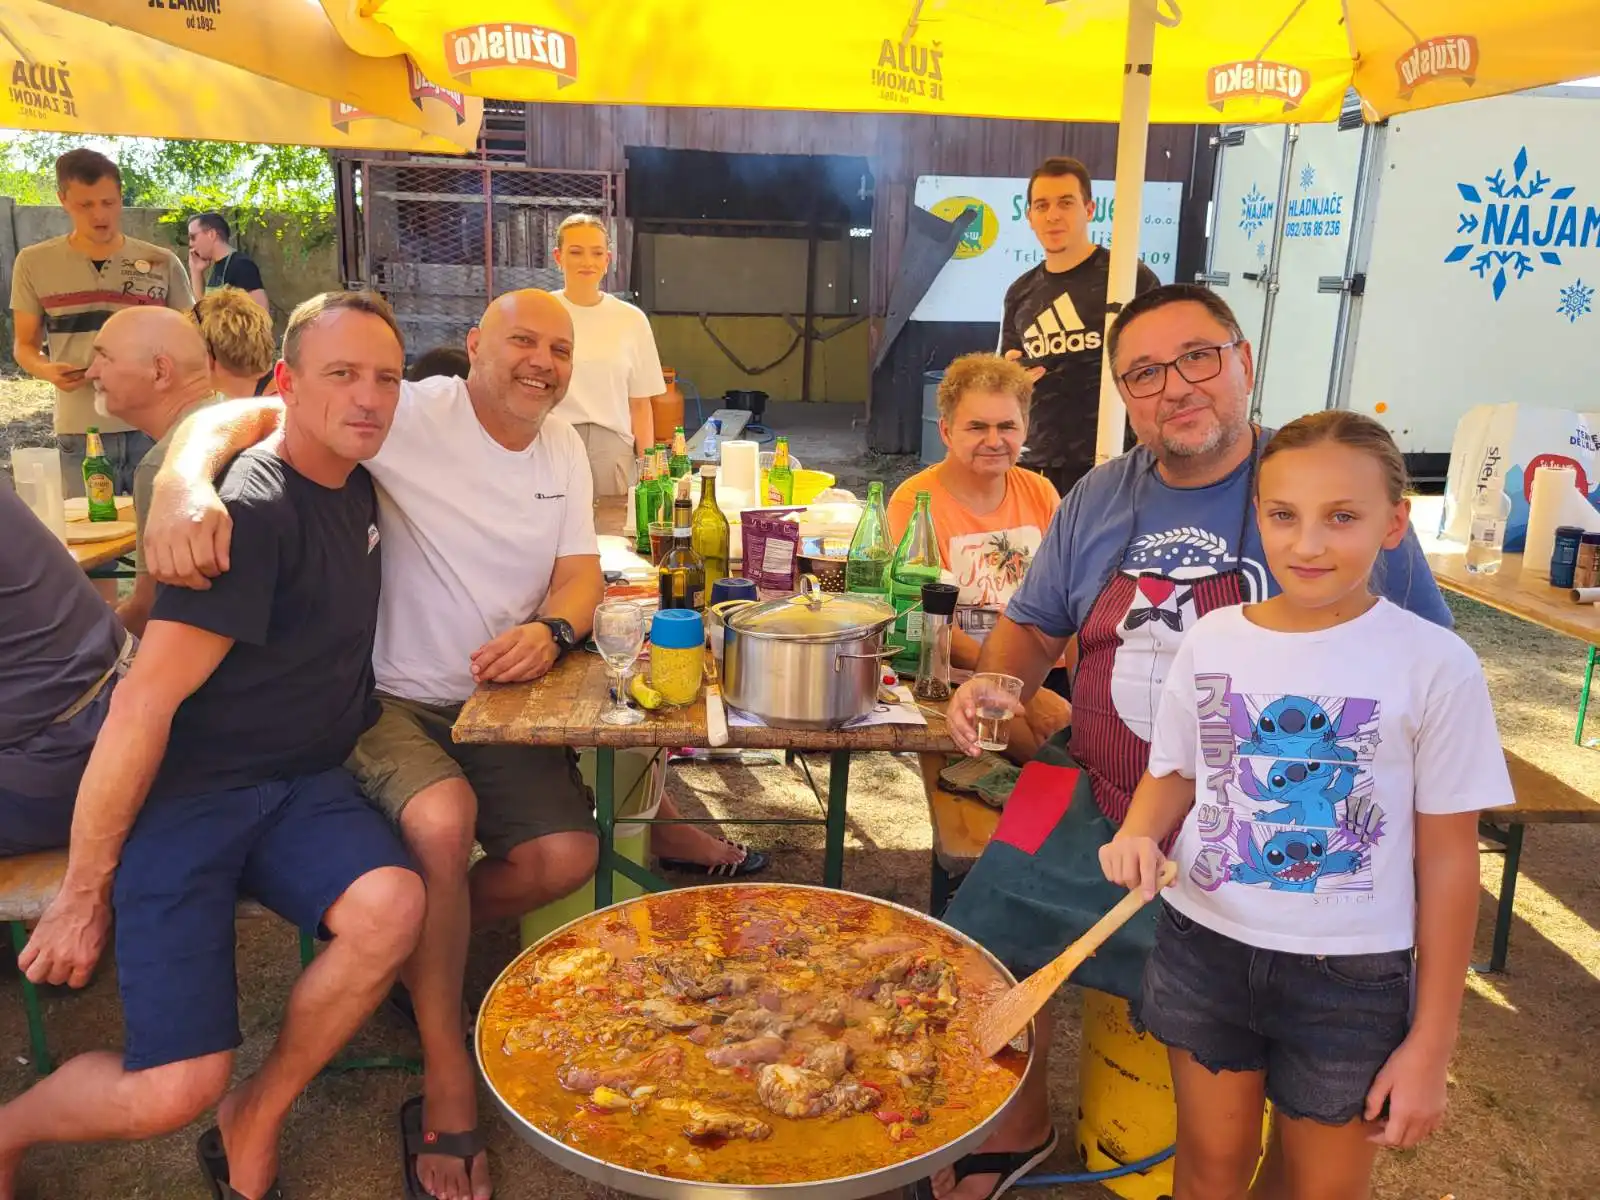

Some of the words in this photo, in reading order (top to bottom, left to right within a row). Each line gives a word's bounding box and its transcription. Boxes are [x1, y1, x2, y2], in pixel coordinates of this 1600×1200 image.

[1246, 202, 1273, 220] NAJAM
[1287, 192, 1343, 217] HLADNJAČE
[1481, 203, 1600, 247] NAJAM
